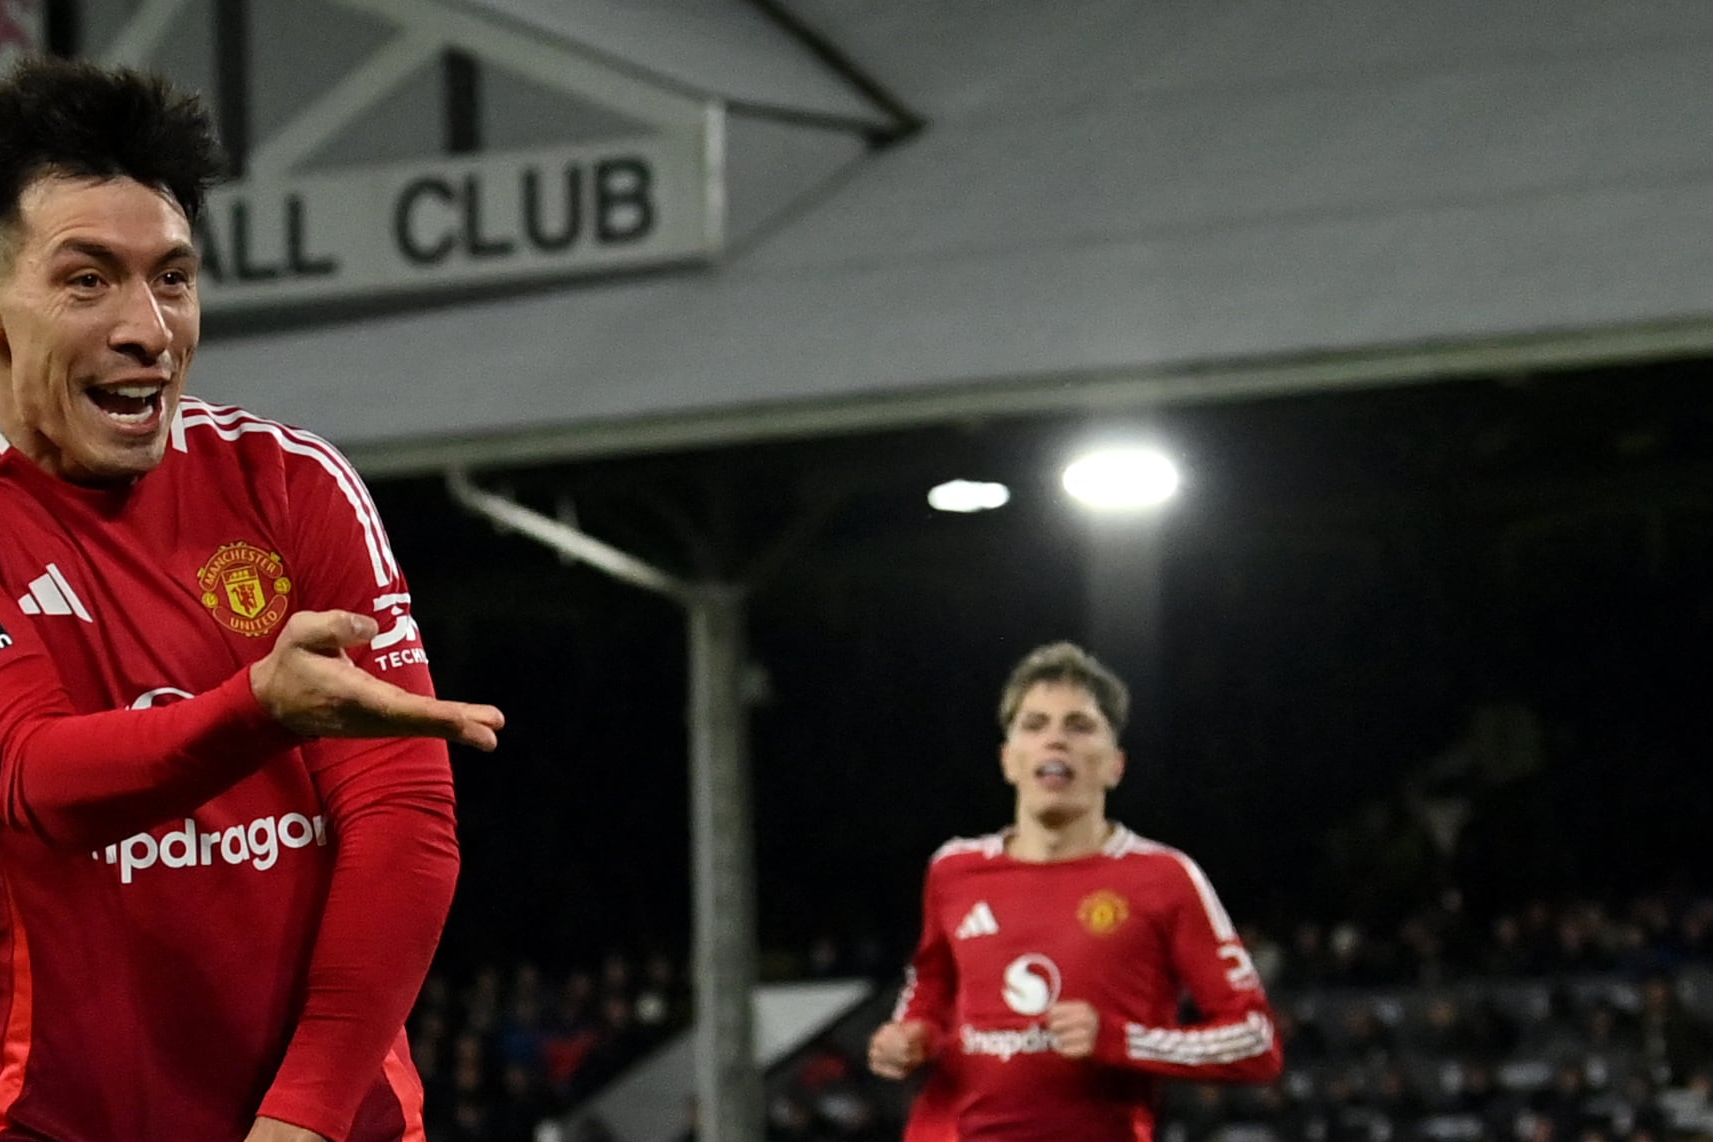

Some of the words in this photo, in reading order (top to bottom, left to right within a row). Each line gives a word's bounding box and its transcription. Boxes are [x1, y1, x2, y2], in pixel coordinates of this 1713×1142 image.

[393, 156, 656, 267] CLUB
[204, 549, 277, 586] MANCHESTER
[230, 610, 278, 631] UNITED
